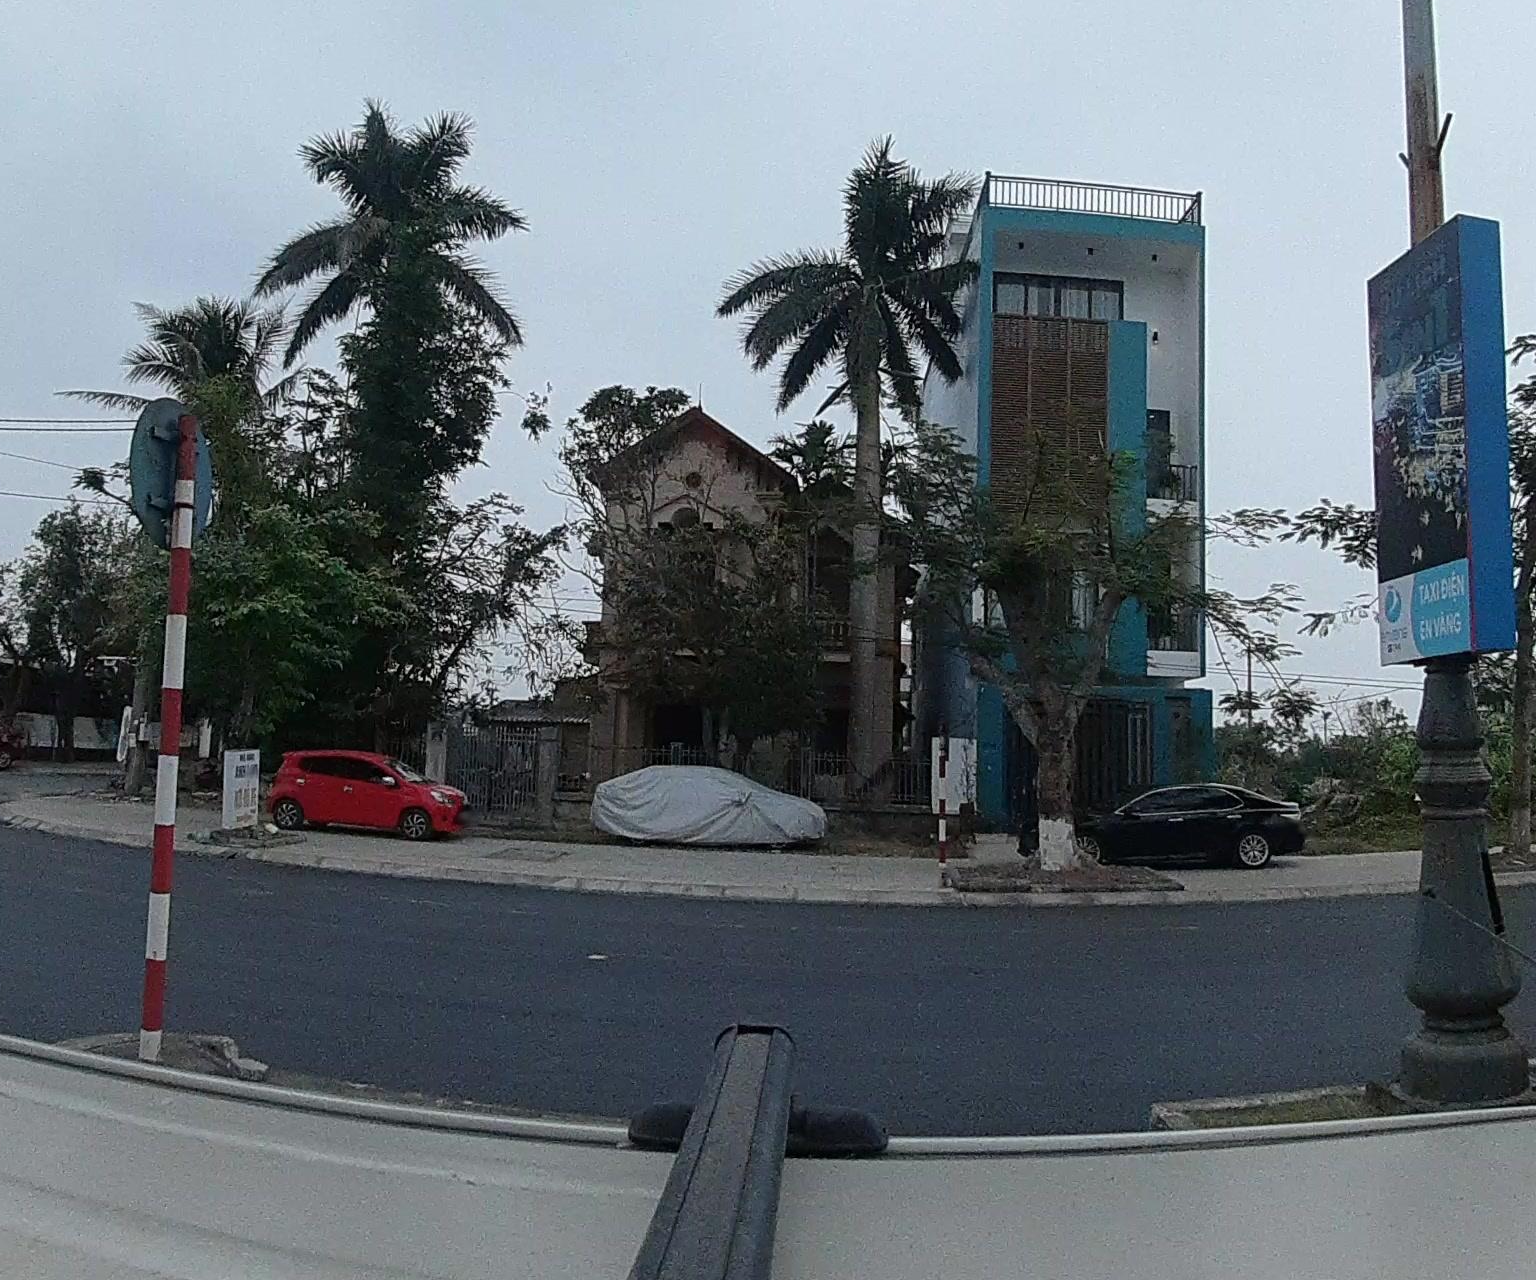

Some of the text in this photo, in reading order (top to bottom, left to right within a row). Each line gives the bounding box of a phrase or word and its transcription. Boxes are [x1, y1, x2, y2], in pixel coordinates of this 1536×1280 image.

[1420, 571, 1464, 605] TAXI ĐIỆN
[1420, 616, 1432, 640] ÉN
[1433, 611, 1462, 638] VÀNG
